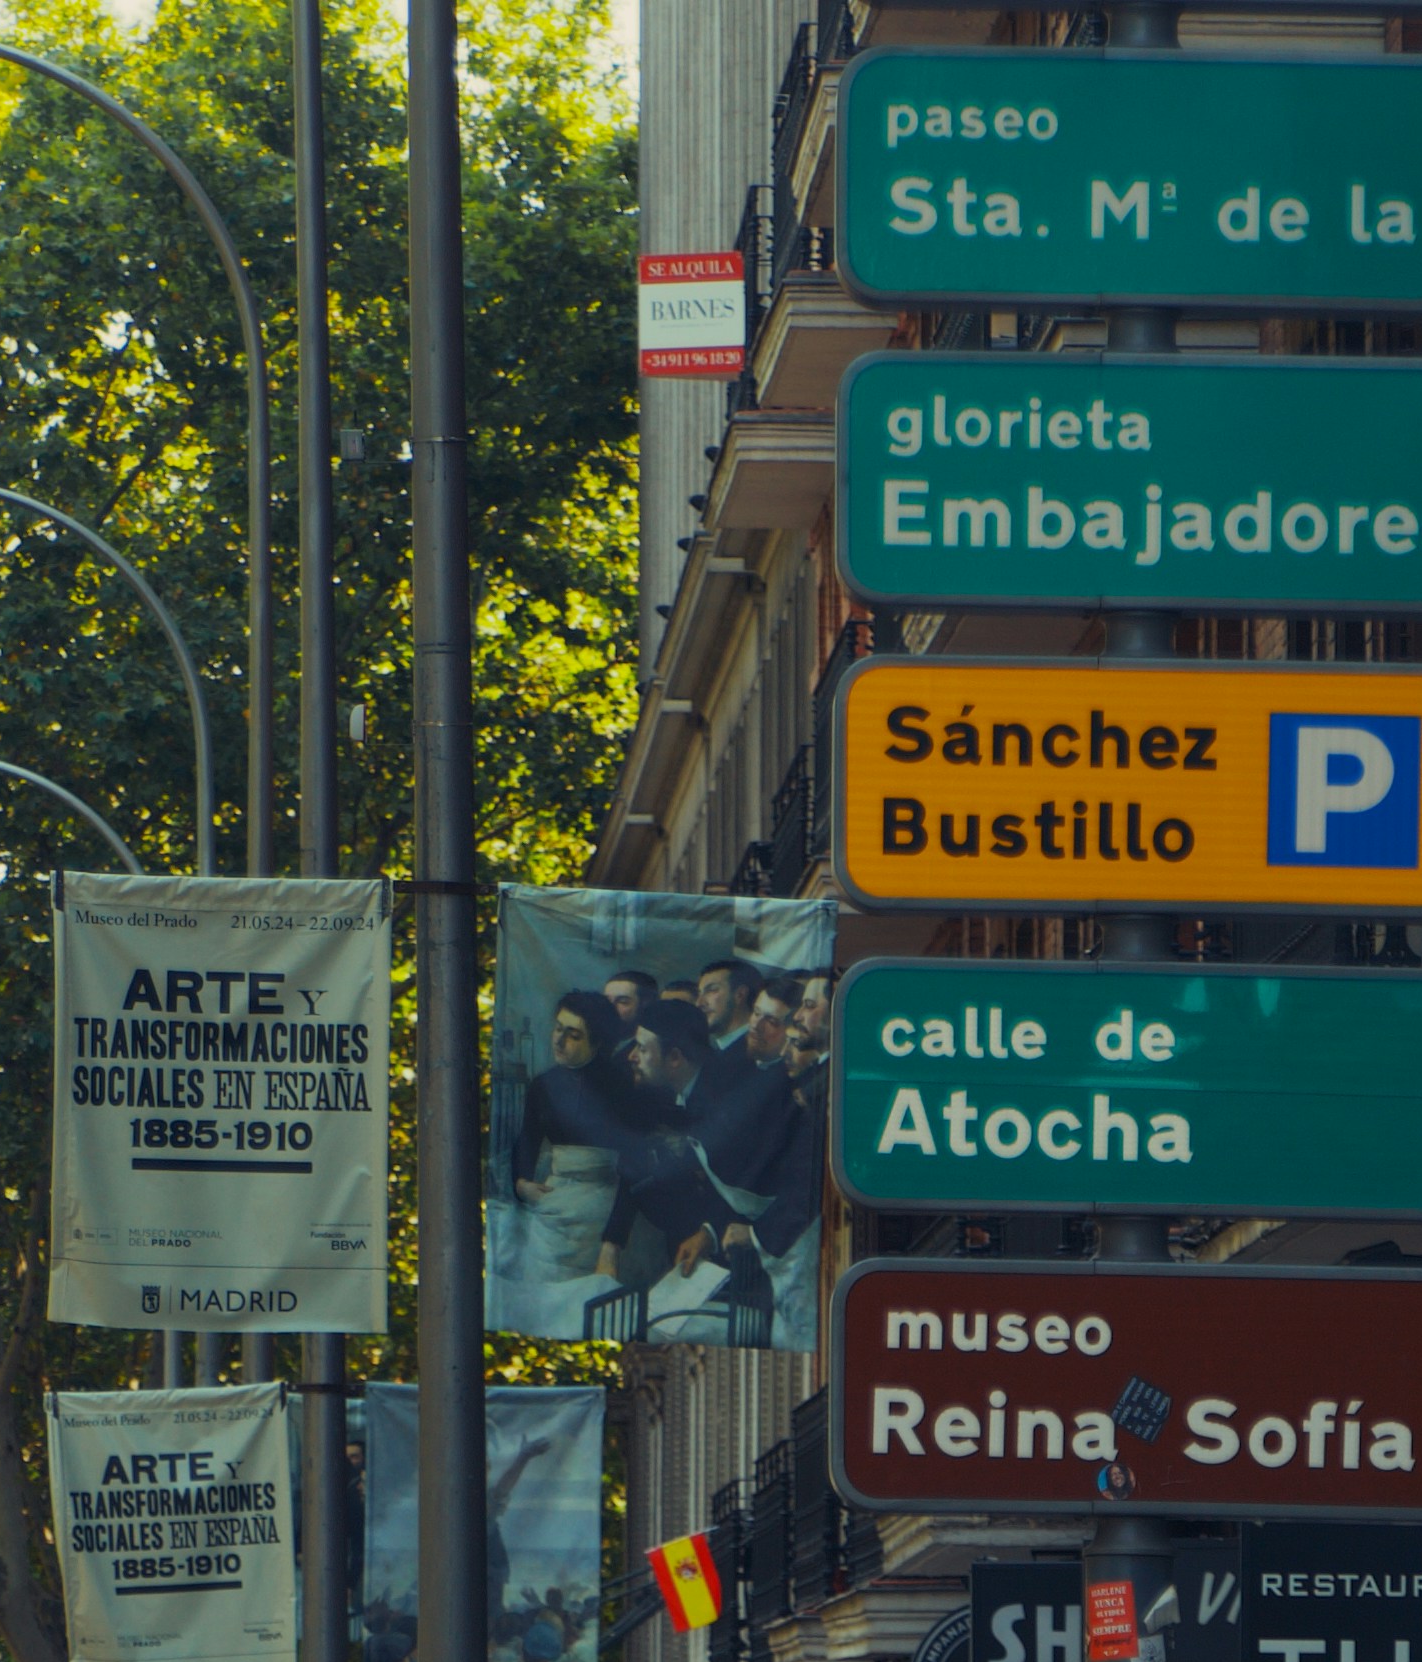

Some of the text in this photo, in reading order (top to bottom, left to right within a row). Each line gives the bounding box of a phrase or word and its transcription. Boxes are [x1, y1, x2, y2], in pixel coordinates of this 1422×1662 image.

[886, 104, 1059, 147] paseo
[889, 177, 1049, 238] Sta.
[1217, 187, 1309, 244] de
[1351, 185, 1416, 246] la
[647, 259, 735, 279] SE ALQUILA
[650, 298, 735, 321] BARNES
[887, 396, 1152, 457] glorieta
[884, 704, 1395, 854] Sánchez P
[882, 796, 1195, 863] Bustillo
[74, 911, 123, 928] Museo
[127, 912, 150, 927] del
[154, 914, 198, 929] Prado
[230, 915, 294, 931] 21.05.24
[308, 916, 375, 932] 22.09.24
[122, 969, 328, 1016] ARTE Y
[73, 1017, 369, 1064] TRANSFORMACIONES
[880, 1007, 1177, 1062] calle de
[72, 1066, 373, 1112] SOCIALES EN ESPAÑA
[129, 1118, 313, 1151] 1885-1910
[877, 1088, 1194, 1164] Atocha
[128, 1228, 167, 1238] MUSEO
[169, 1229, 223, 1240] NACIONAL
[151, 1238, 192, 1248] PRADO
[330, 1240, 367, 1251] BBVA
[180, 1289, 298, 1314] MADRID
[885, 1311, 1113, 1356] museo
[64, 1417, 95, 1429] Museo
[96, 1416, 118, 1428] del
[120, 1415, 151, 1427] Prado
[872, 1386, 1119, 1461] Reina
[1183, 1399, 1415, 1472] Sofía
[101, 1452, 244, 1486] ARTE Y
[69, 1483, 276, 1520] TRANSFORMACIONES
[72, 1513, 281, 1552] SOCIALES EN ESPAÑA
[112, 1553, 242, 1581] 1885-1910
[1094, 1597, 1125, 1609] NUNCA
[1092, 1624, 1132, 1636] SIEMPRE
